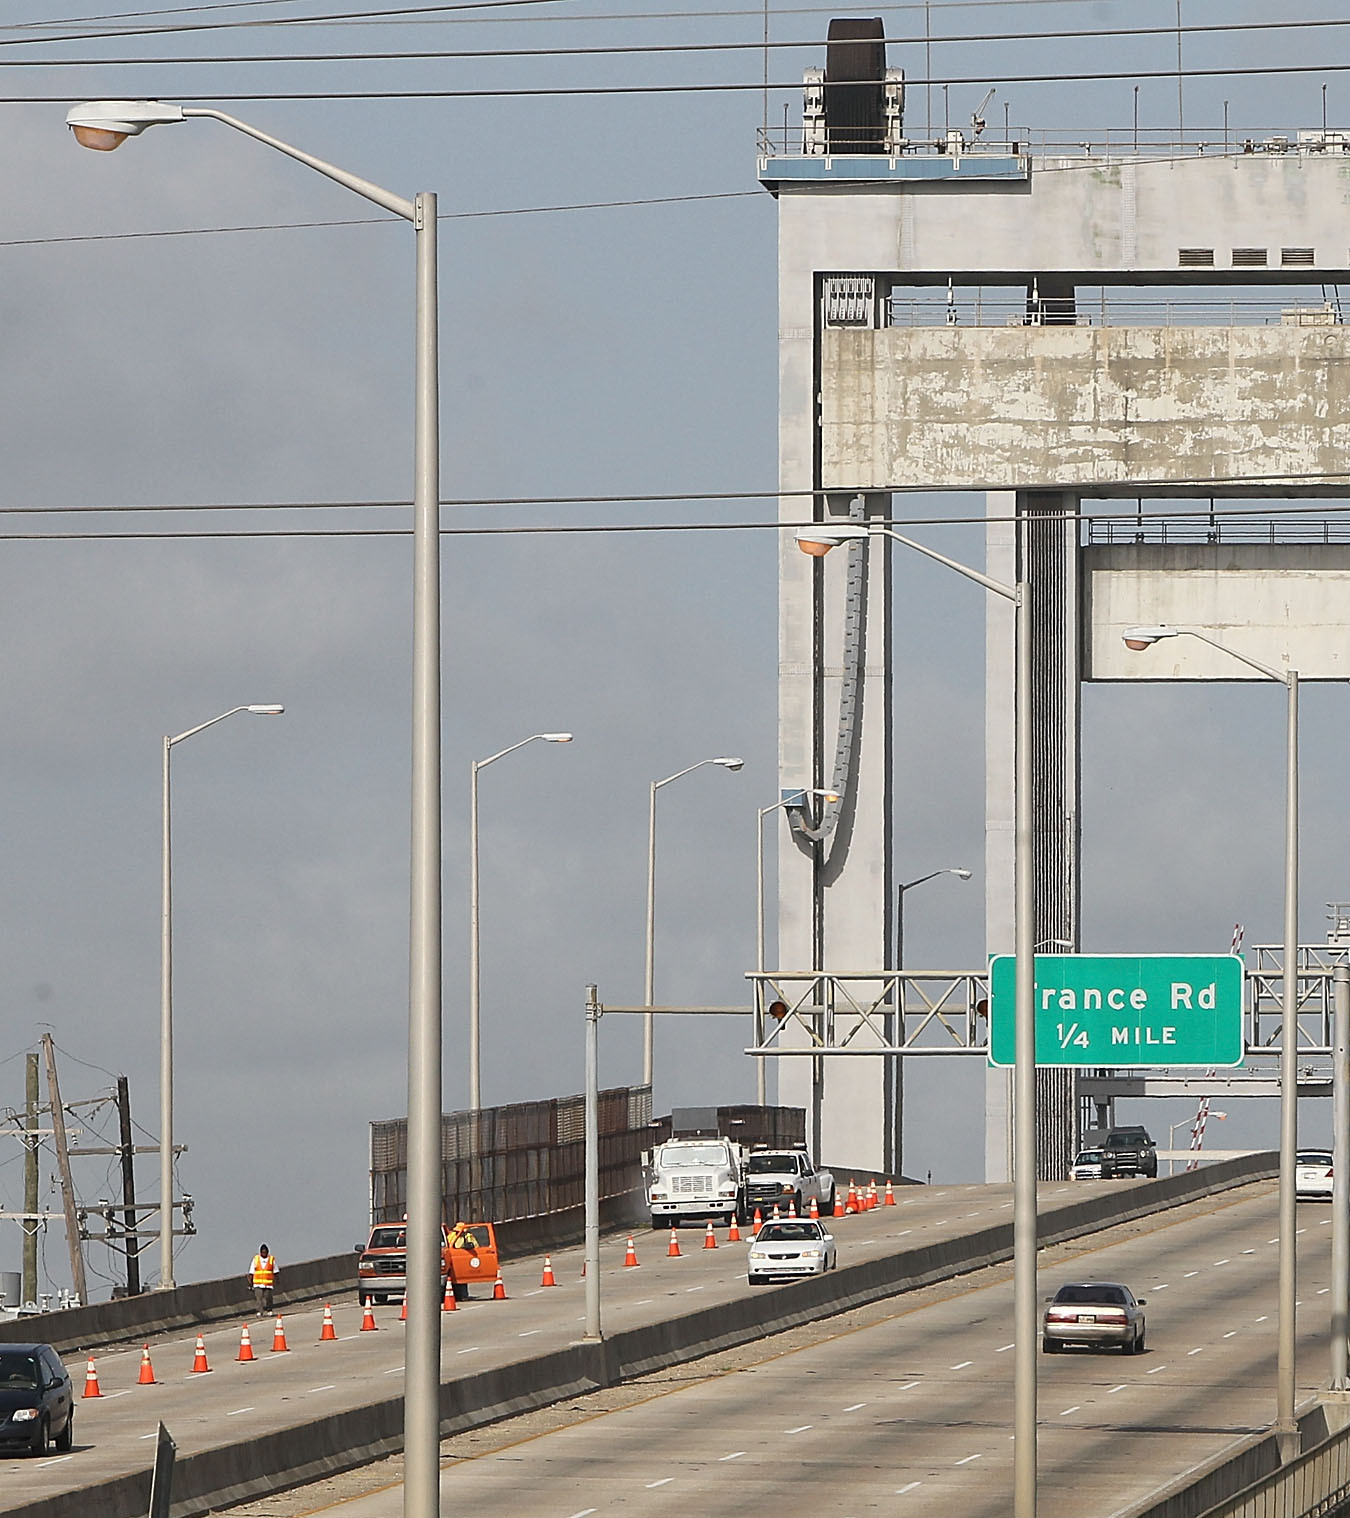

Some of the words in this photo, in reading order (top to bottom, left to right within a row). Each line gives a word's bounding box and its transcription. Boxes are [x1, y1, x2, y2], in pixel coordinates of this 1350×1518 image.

[1034, 982, 1148, 1010] rance
[1171, 982, 1216, 1010] Rd
[1111, 1027, 1176, 1044] MILE
